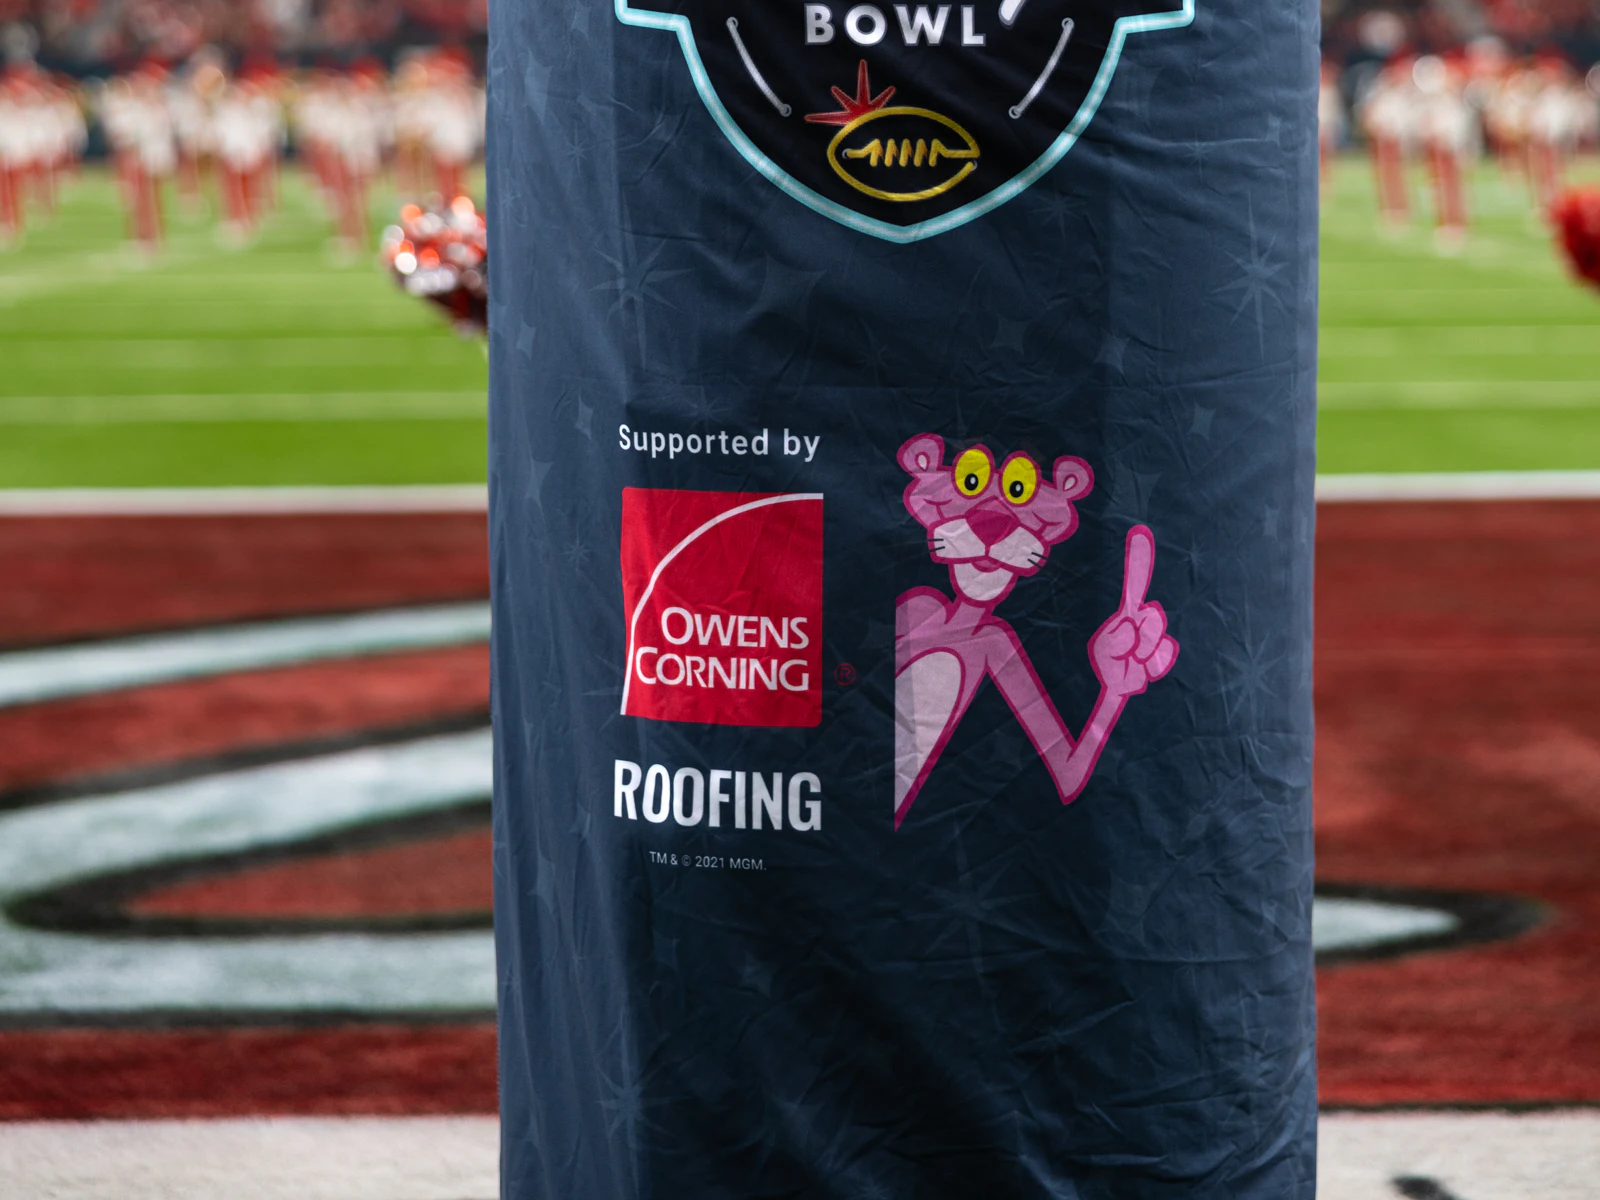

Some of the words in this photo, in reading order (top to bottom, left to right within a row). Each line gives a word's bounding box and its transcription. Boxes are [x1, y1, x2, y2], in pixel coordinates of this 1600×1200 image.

[804, 3, 986, 47] BOWL
[618, 424, 770, 459] Supported
[782, 427, 821, 462] by
[661, 606, 810, 650] OWENS
[635, 646, 810, 692] CORNING
[612, 759, 823, 832] ROOFING
[649, 851, 667, 865] TM
[669, 852, 678, 866] &
[695, 855, 726, 869] 2021
